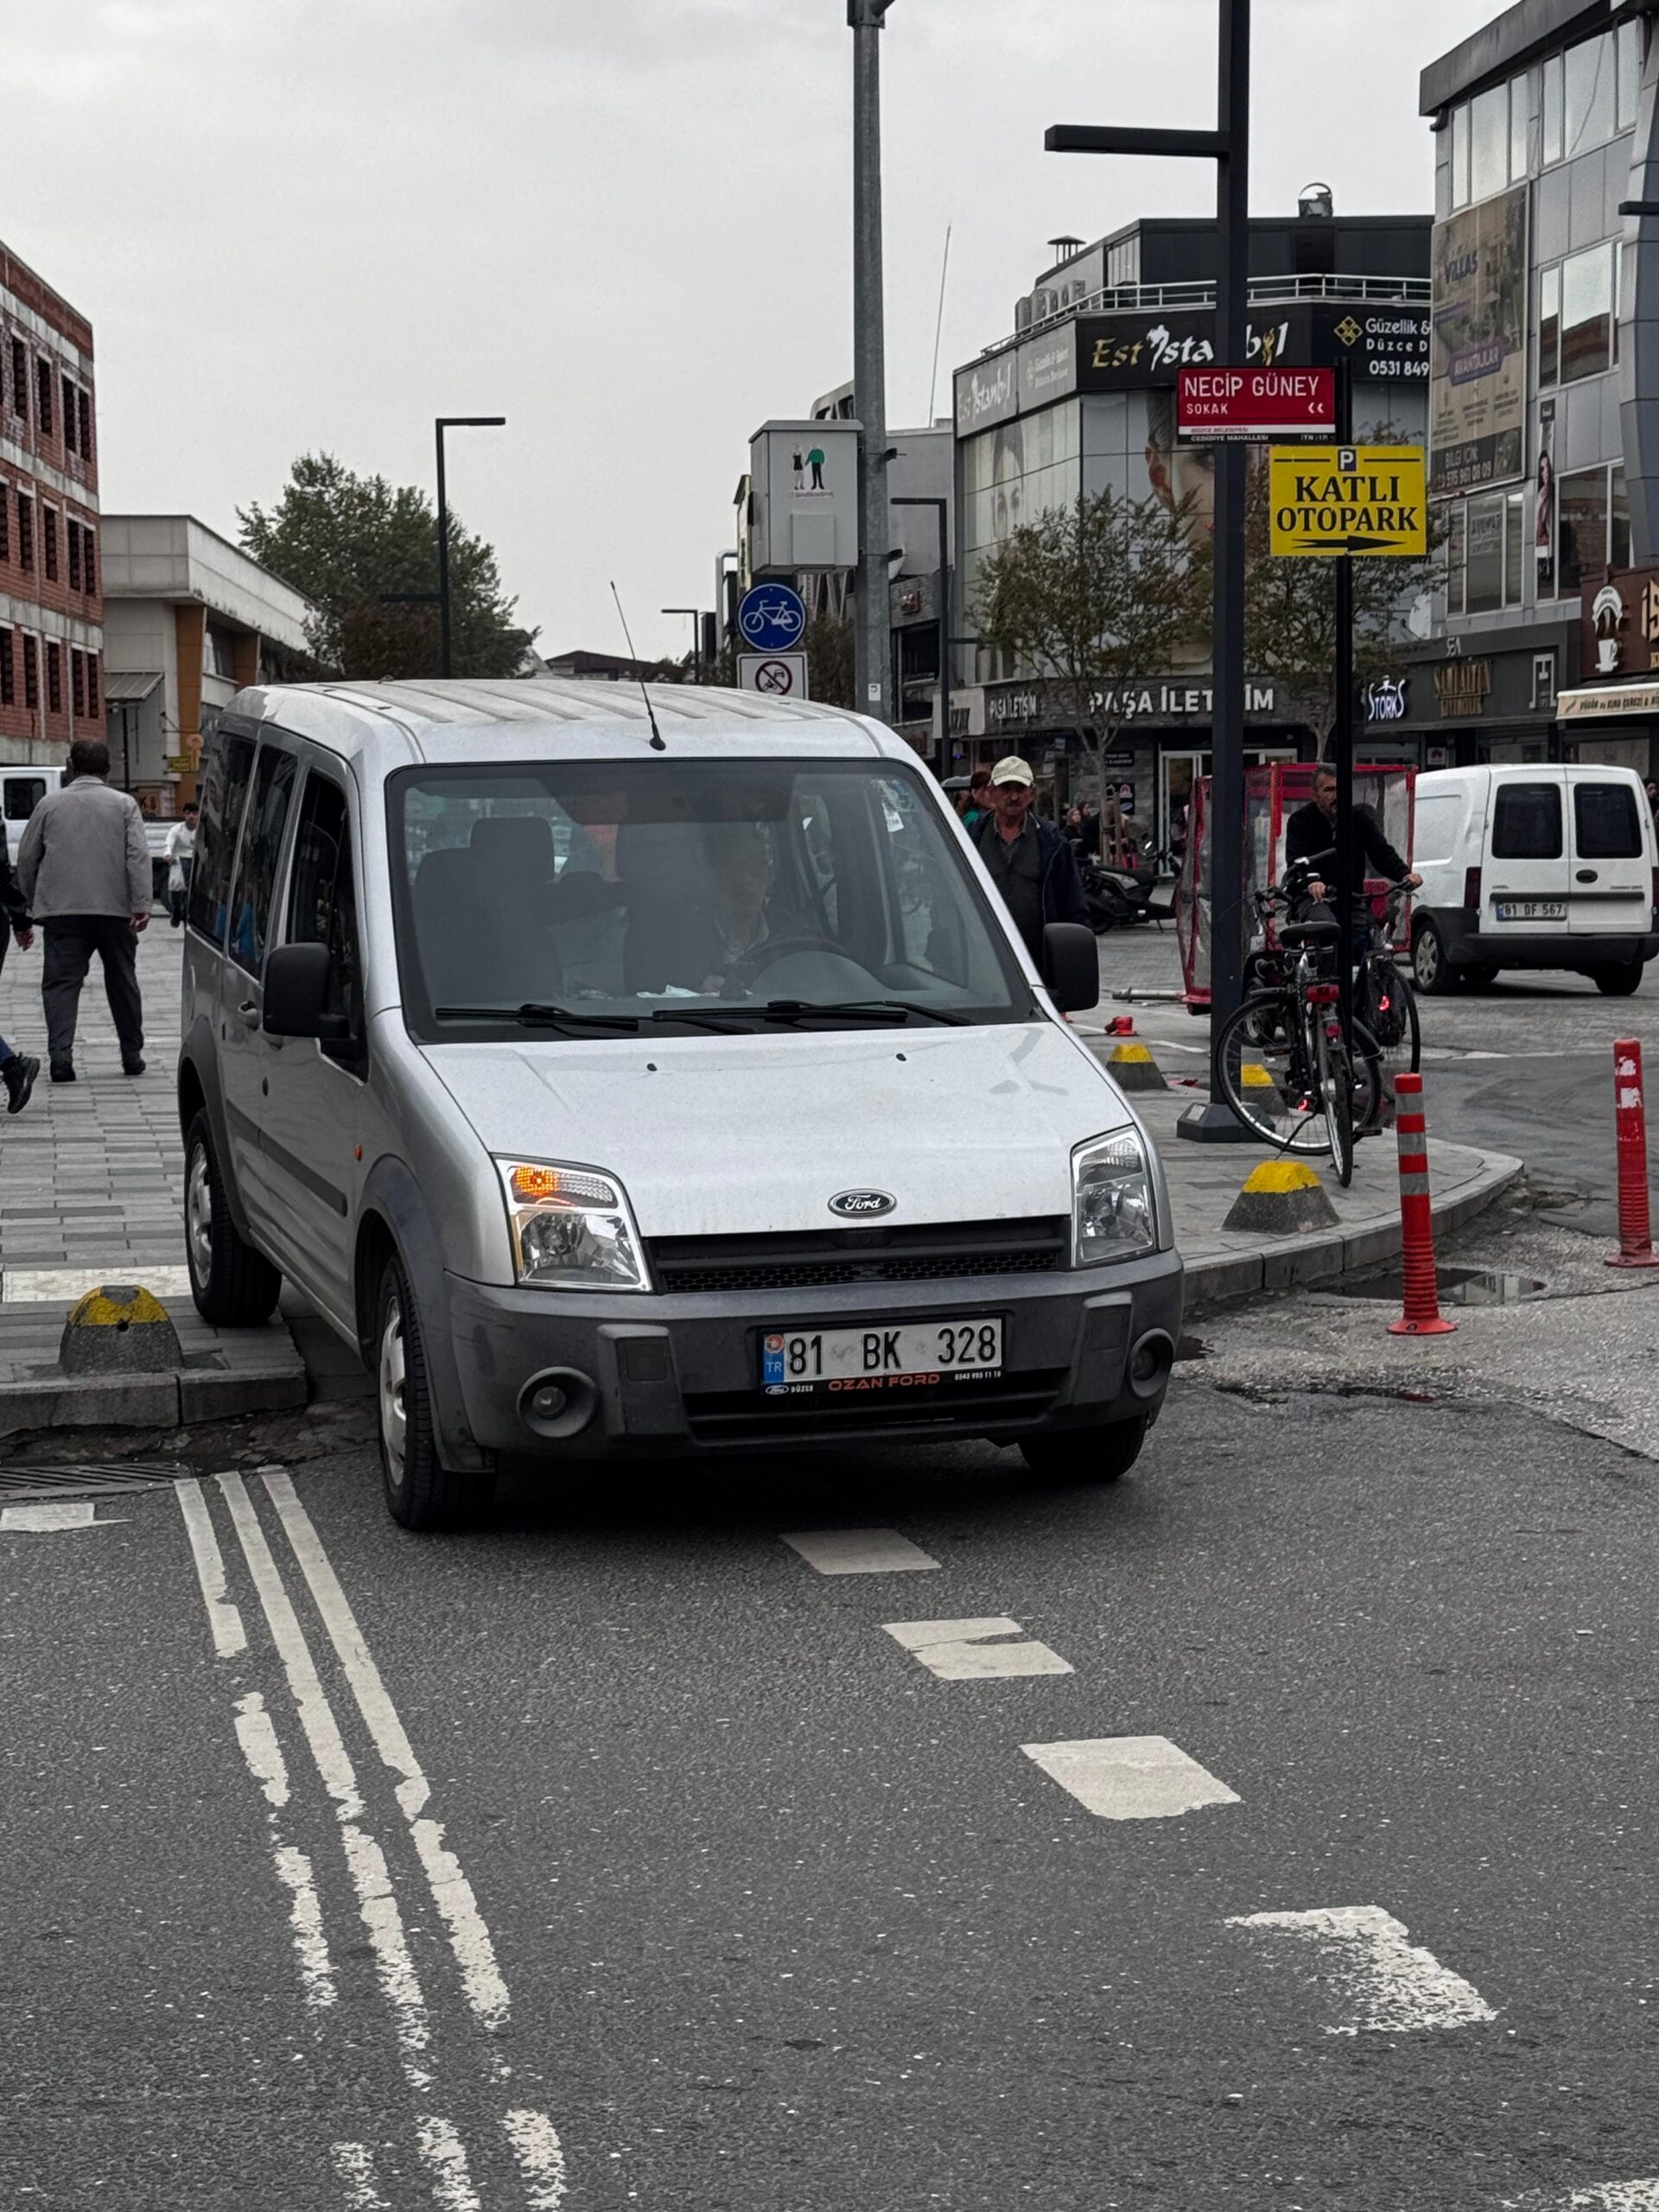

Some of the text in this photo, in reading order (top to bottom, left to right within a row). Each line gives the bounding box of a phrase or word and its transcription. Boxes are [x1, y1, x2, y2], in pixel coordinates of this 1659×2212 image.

[1365, 317, 1418, 334] Güzellik
[1091, 337, 1144, 368] Est
[1366, 338, 1414, 352] Düzce
[1369, 359, 1430, 377] 0531 849
[1185, 372, 1319, 397] NECİP GÜNEY
[1186, 403, 1229, 415] SOKAK
[1340, 451, 1354, 471] P
[1295, 475, 1401, 502] KATLI
[1276, 506, 1419, 532] OTOPARK
[1090, 690, 1154, 719] PAŞA
[844, 1194, 881, 1211] Ford
[766, 1325, 995, 1376] TR 81 BK 328
[828, 1377, 877, 1392] OZAN
[887, 1373, 941, 1387] FORD
